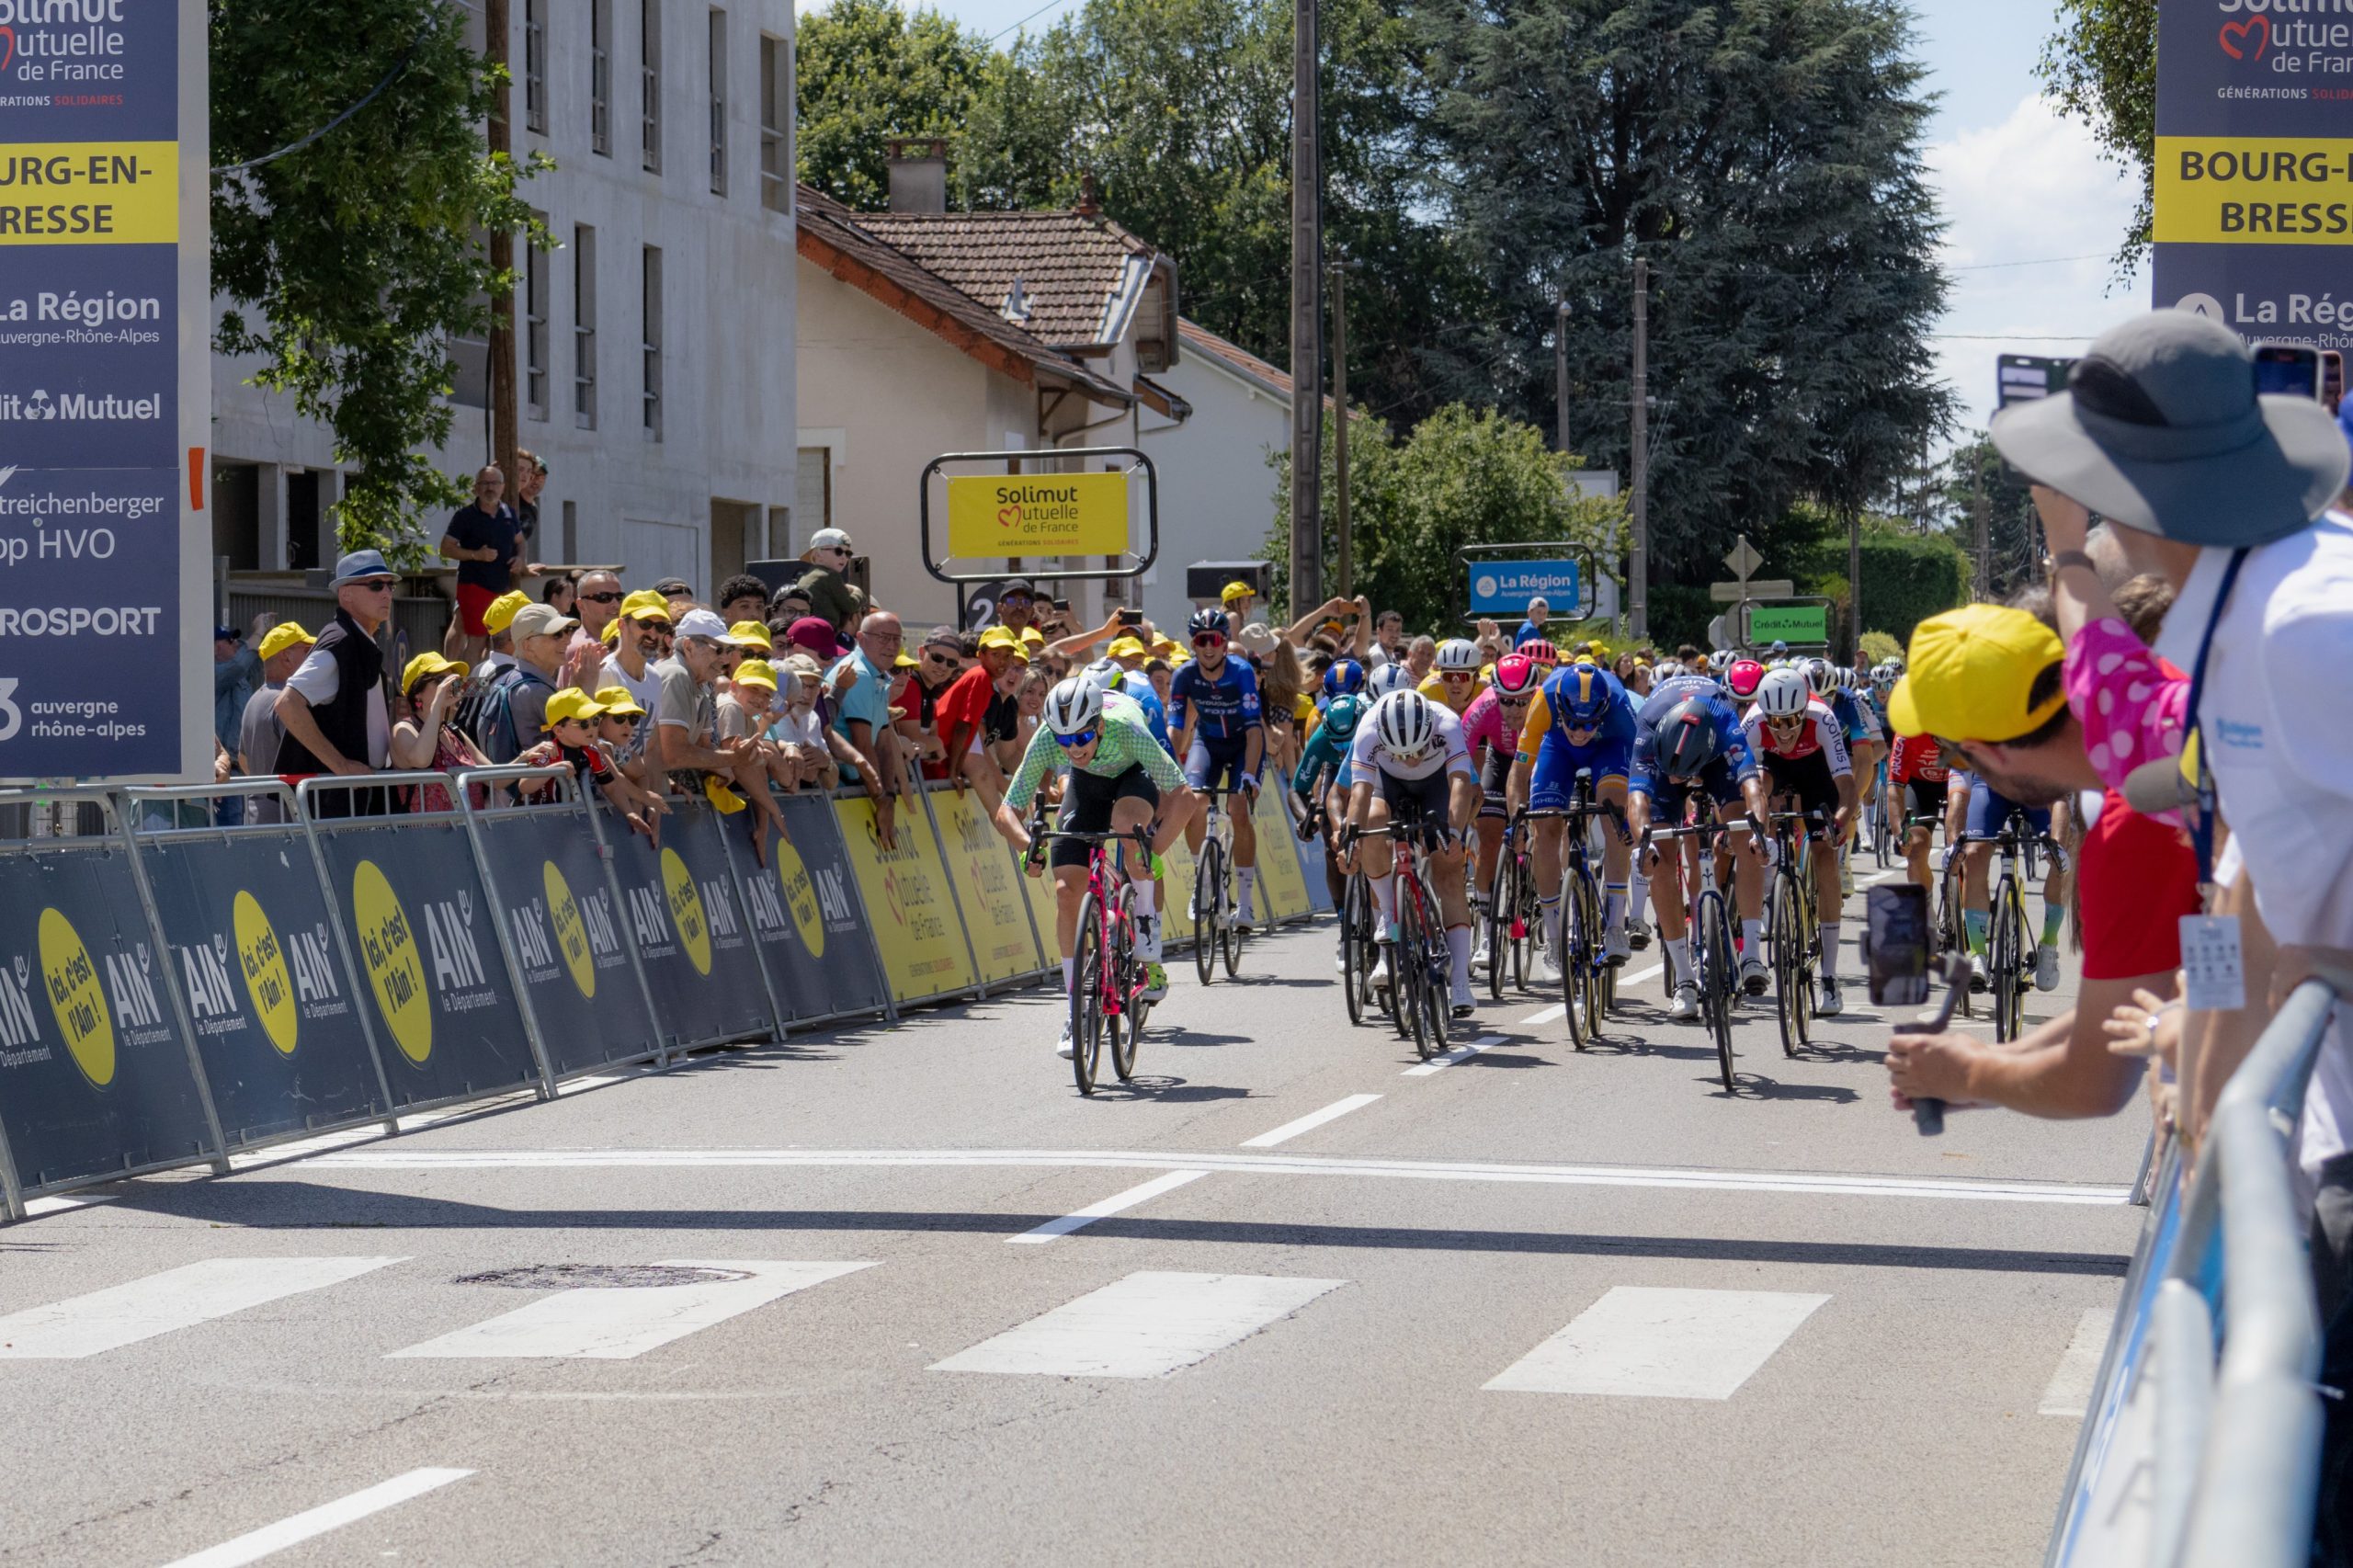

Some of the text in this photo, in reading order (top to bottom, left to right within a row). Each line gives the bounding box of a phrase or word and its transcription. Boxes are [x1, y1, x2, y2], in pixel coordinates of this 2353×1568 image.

[17, 61, 123, 81] de France
[2271, 52, 2301, 73] de
[54, 95, 123, 106] SOLIDAIRES
[2217, 85, 2353, 100] GÉNÉRATIONS SOLID
[0, 204, 113, 234] RESSE
[2221, 202, 2353, 234] BRESS
[39, 290, 160, 326] Région
[2235, 293, 2280, 324] La
[0, 328, 159, 347] uvergne-Rhône-Alpes
[61, 392, 161, 420] Mutuel
[996, 485, 1078, 505] Solimut
[1023, 522, 1078, 533] de France
[40, 528, 115, 559] HVO
[1500, 574, 1571, 590] La Région
[1754, 619, 1823, 629] Crédit Mutuel
[30, 701, 118, 718] auvergne
[32, 720, 145, 740] rhône-alpes
[703, 881, 737, 937] AIN
[747, 876, 785, 930] AIN
[815, 869, 851, 921] AIN
[582, 895, 619, 955] AIN
[629, 887, 669, 945] AIN
[242, 926, 278, 980] Ici, c'est
[362, 904, 408, 971] Ici, c'est
[424, 902, 485, 991] AIN
[512, 906, 553, 969] AIN
[48, 947, 92, 1006] Ici, c'est
[182, 944, 237, 1017] AIN
[290, 932, 338, 1002] AIN
[106, 953, 162, 1028] AIN
[384, 966, 413, 1014] l'Ain
[441, 988, 497, 1013] le Département
[68, 1001, 97, 1042] l'Ain
[203, 1016, 247, 1037] Département
[131, 1028, 172, 1048] Département
